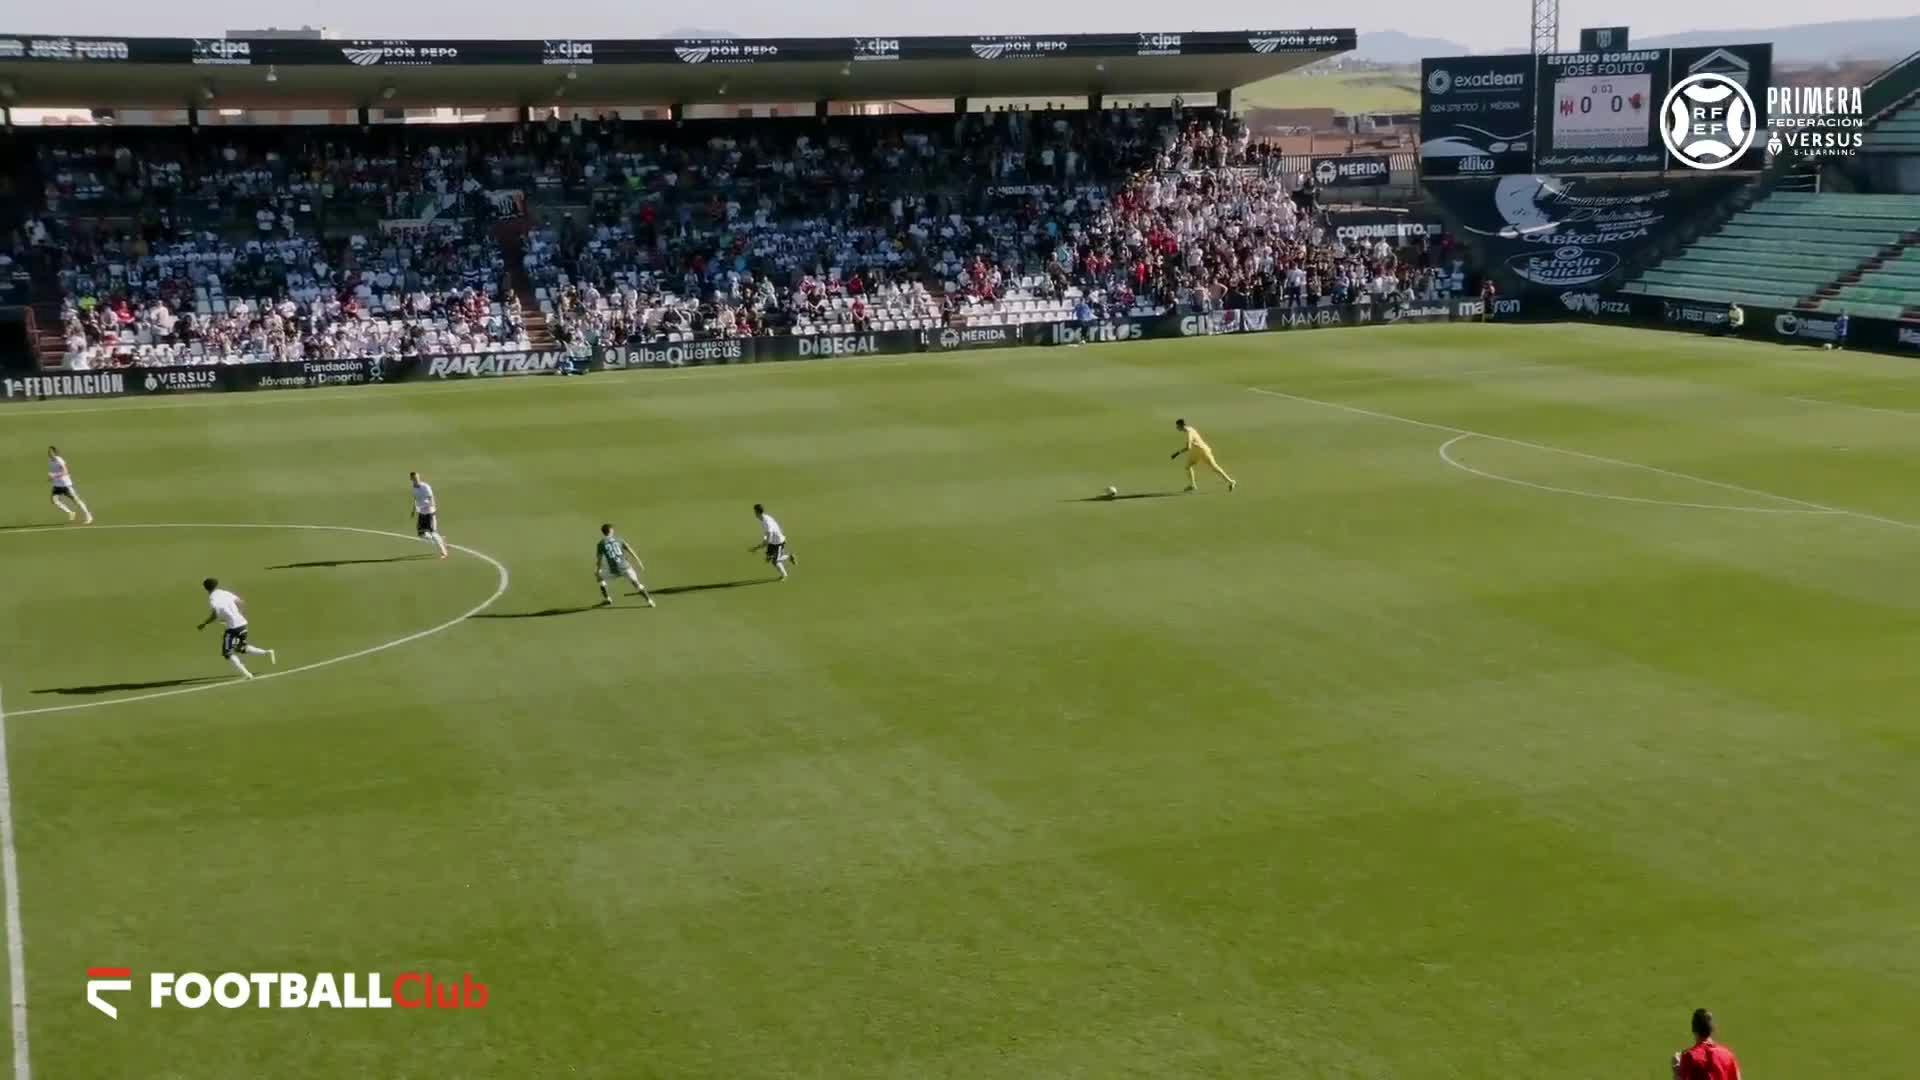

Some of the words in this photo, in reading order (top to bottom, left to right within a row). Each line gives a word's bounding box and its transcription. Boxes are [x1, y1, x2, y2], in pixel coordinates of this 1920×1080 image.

[383, 48, 416, 57] DON
[420, 48, 458, 57] PEPO
[712, 46, 740, 55] DON
[744, 46, 778, 55] PEPO
[1005, 42, 1031, 51] DON
[1036, 41, 1067, 51] PEPO
[1547, 54, 1599, 65] ESTADIO
[1602, 51, 1660, 63] ROMANO
[1560, 64, 1593, 76] JOSÉ
[1598, 62, 1645, 75] FOUTO
[1580, 96, 1592, 113] 0
[1611, 95, 1623, 112] 0
[1529, 257, 1601, 268] Estrella
[1459, 300, 1521, 316] maron
[1600, 302, 1631, 313] PIZZA
[1281, 311, 1342, 326] MAMBA
[304, 360, 363, 372] Fundación
[158, 371, 216, 384] VERSUS
[24, 372, 123, 397] FEDERACIÓN
